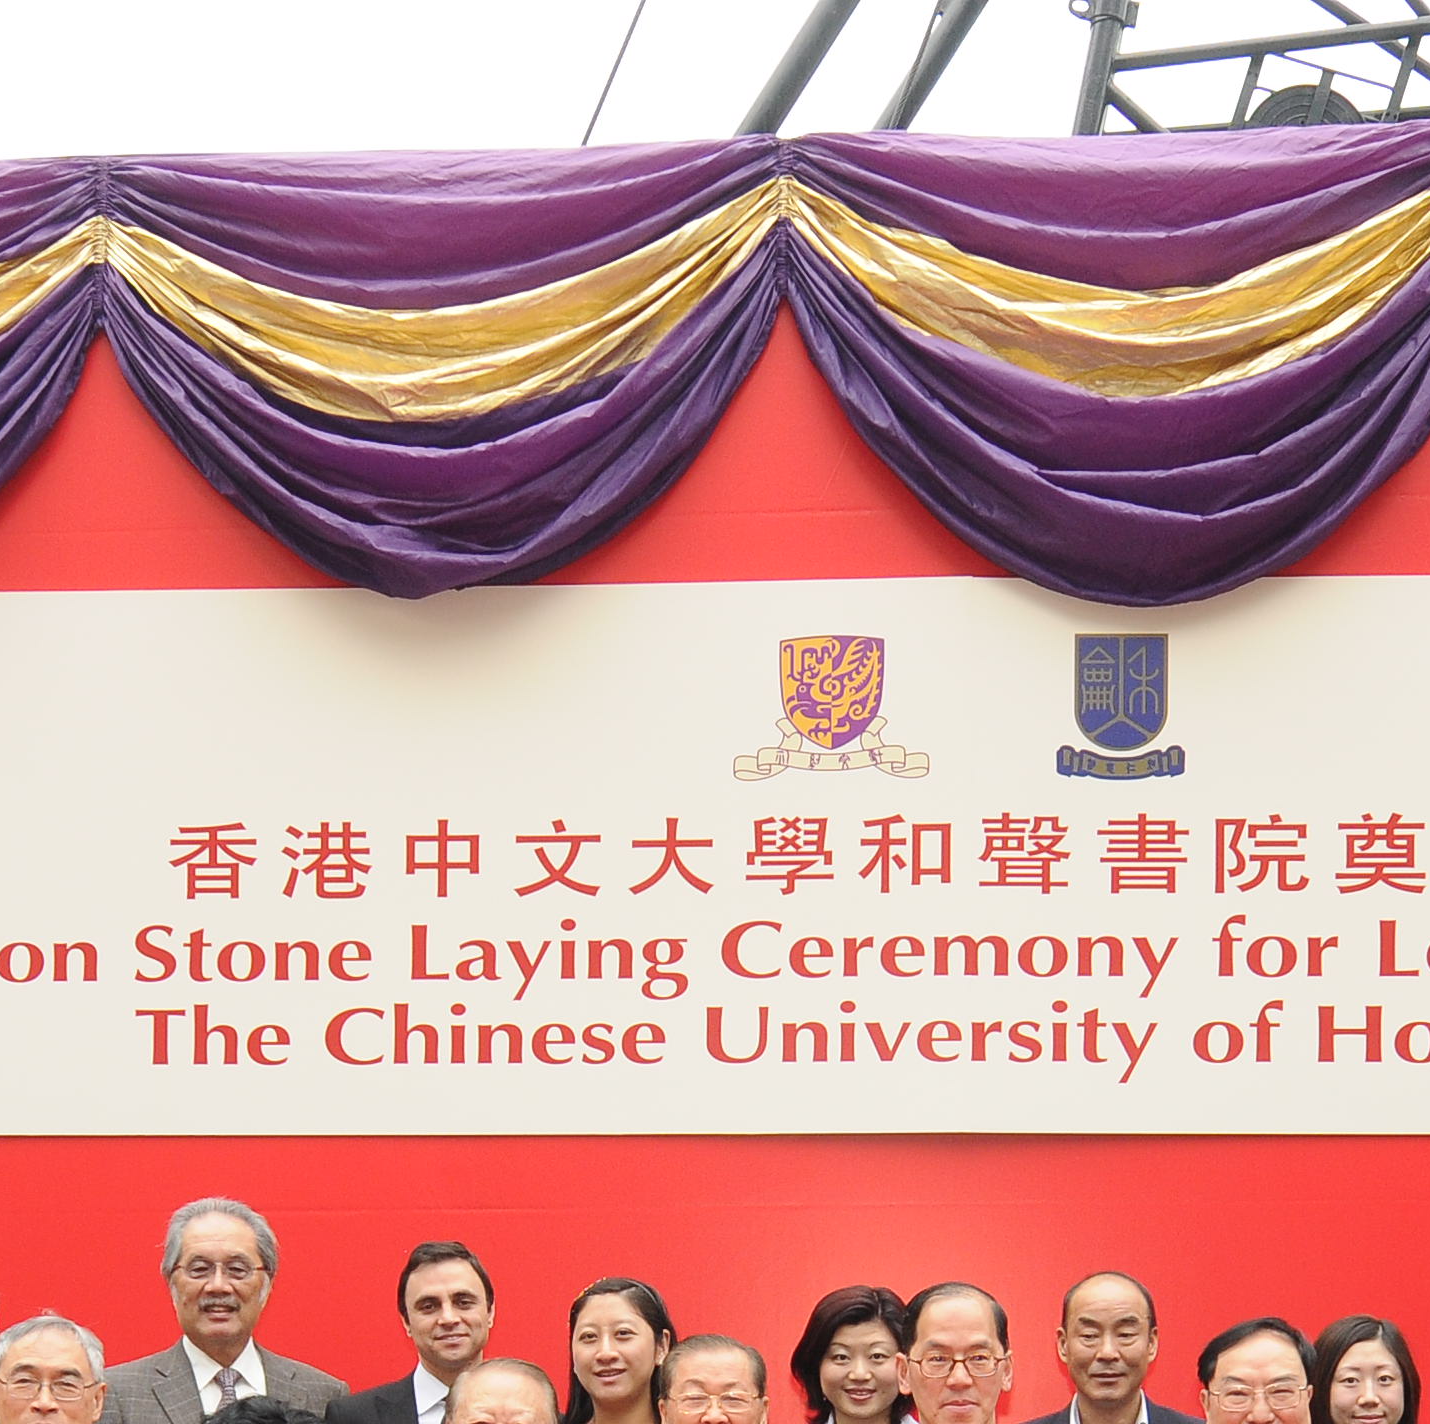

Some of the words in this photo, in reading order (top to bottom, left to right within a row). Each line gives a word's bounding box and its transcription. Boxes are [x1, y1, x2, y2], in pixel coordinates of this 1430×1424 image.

[135, 922, 372, 982] Stone
[411, 919, 688, 1000] Laying
[722, 920, 1179, 998] Ceremony
[1213, 914, 1339, 978] for
[135, 1004, 291, 1066] The
[325, 1003, 666, 1065] Chinese
[707, 1000, 1158, 1084] University
[1194, 1000, 1283, 1063] of
